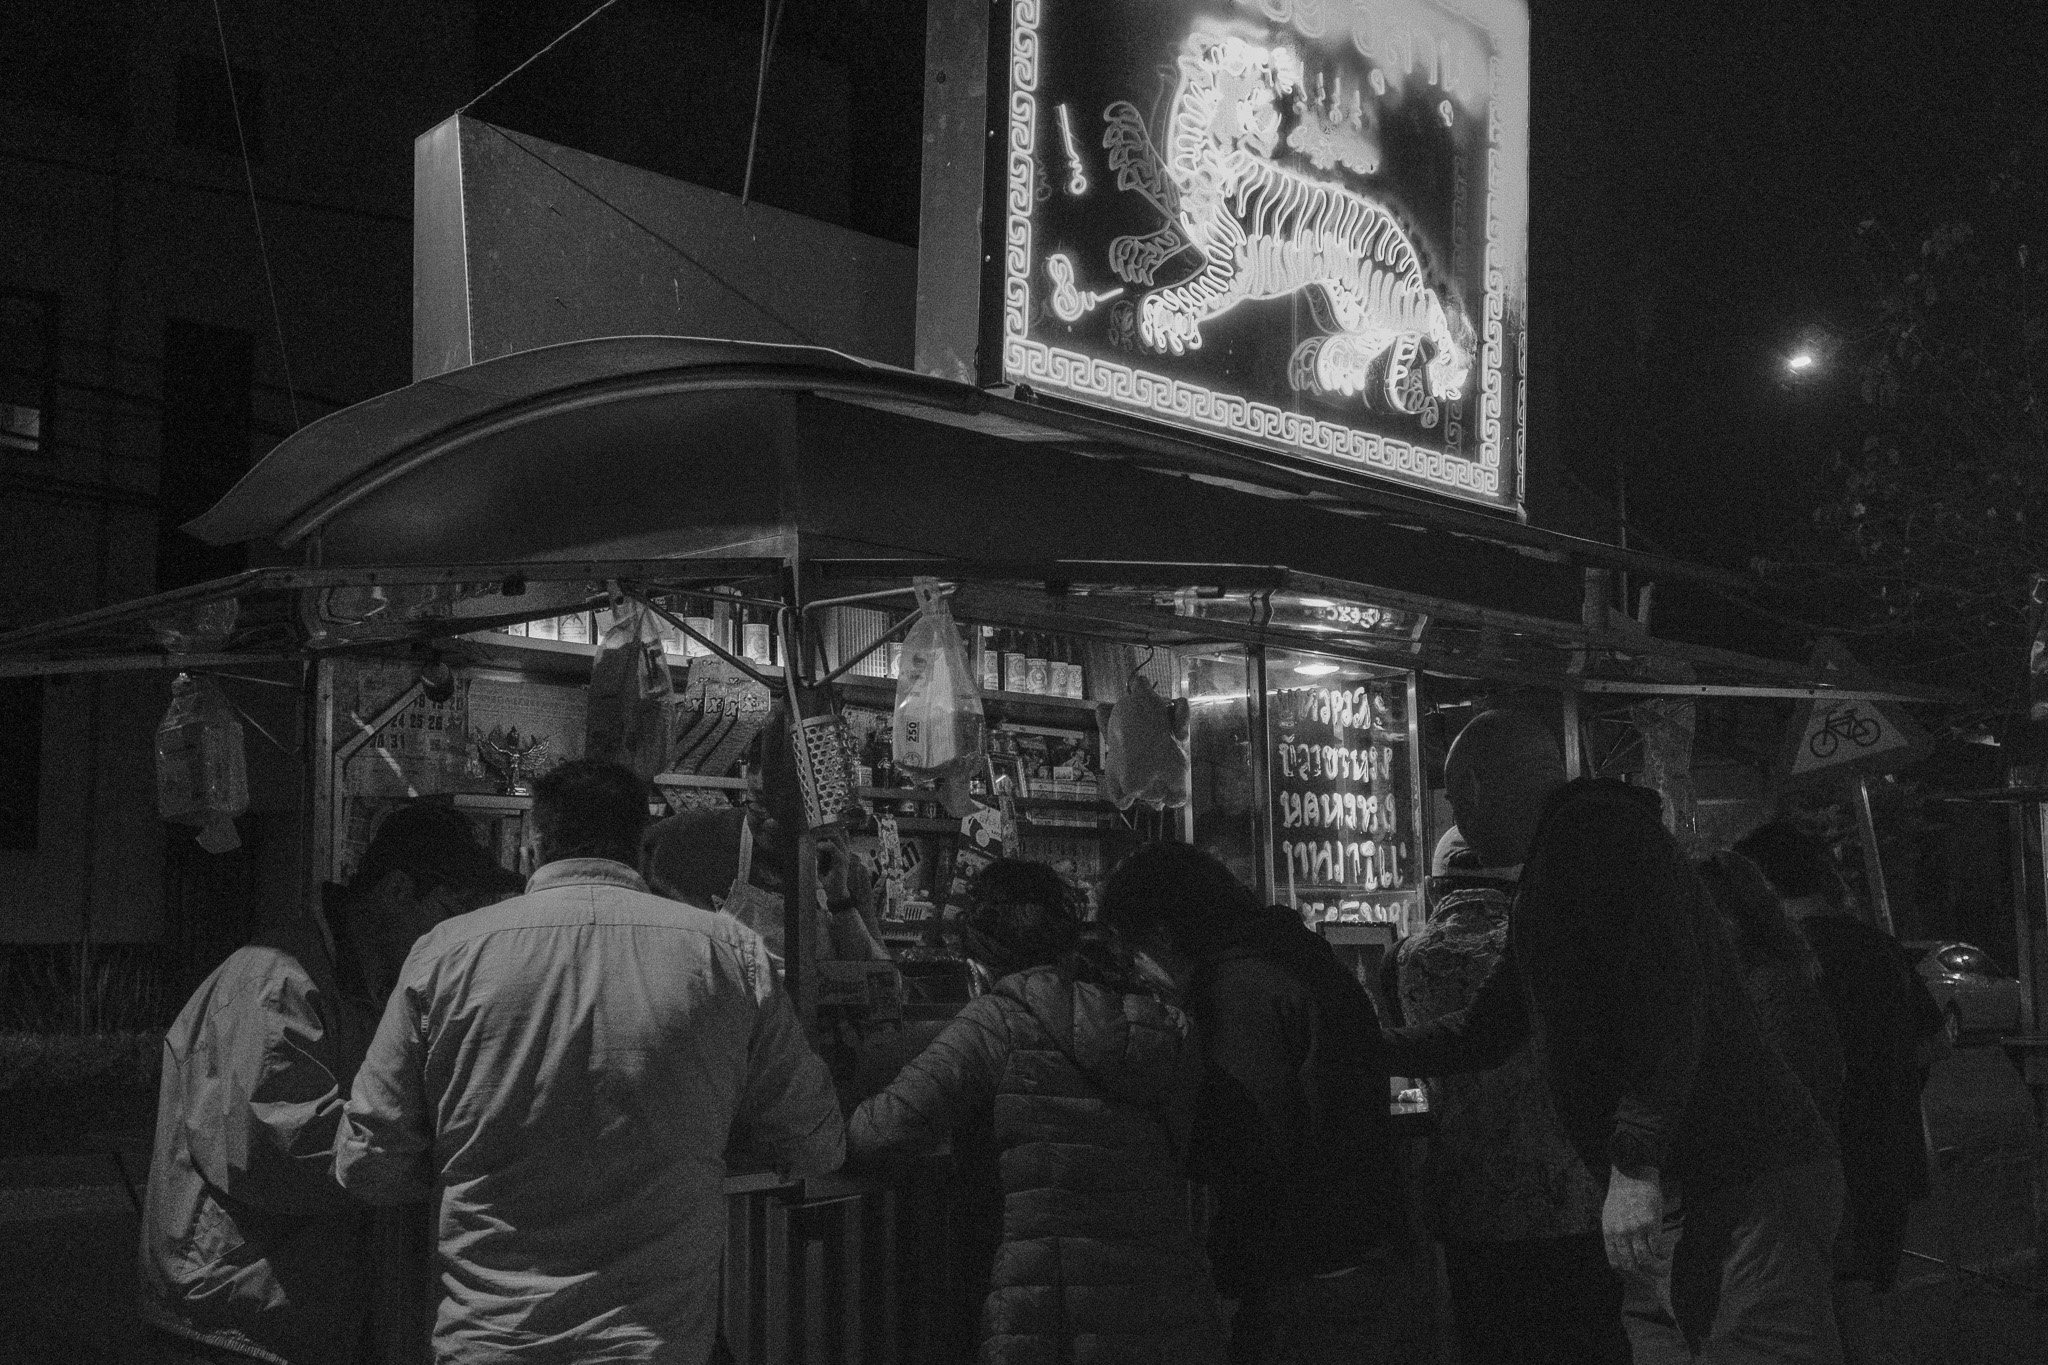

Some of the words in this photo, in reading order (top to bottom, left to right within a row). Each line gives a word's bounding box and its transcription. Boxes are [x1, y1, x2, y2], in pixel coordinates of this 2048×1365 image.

[410, 714, 424, 729] 25
[428, 716, 443, 730] 26
[908, 722, 917, 742] 250
[390, 734, 405, 749] 31
